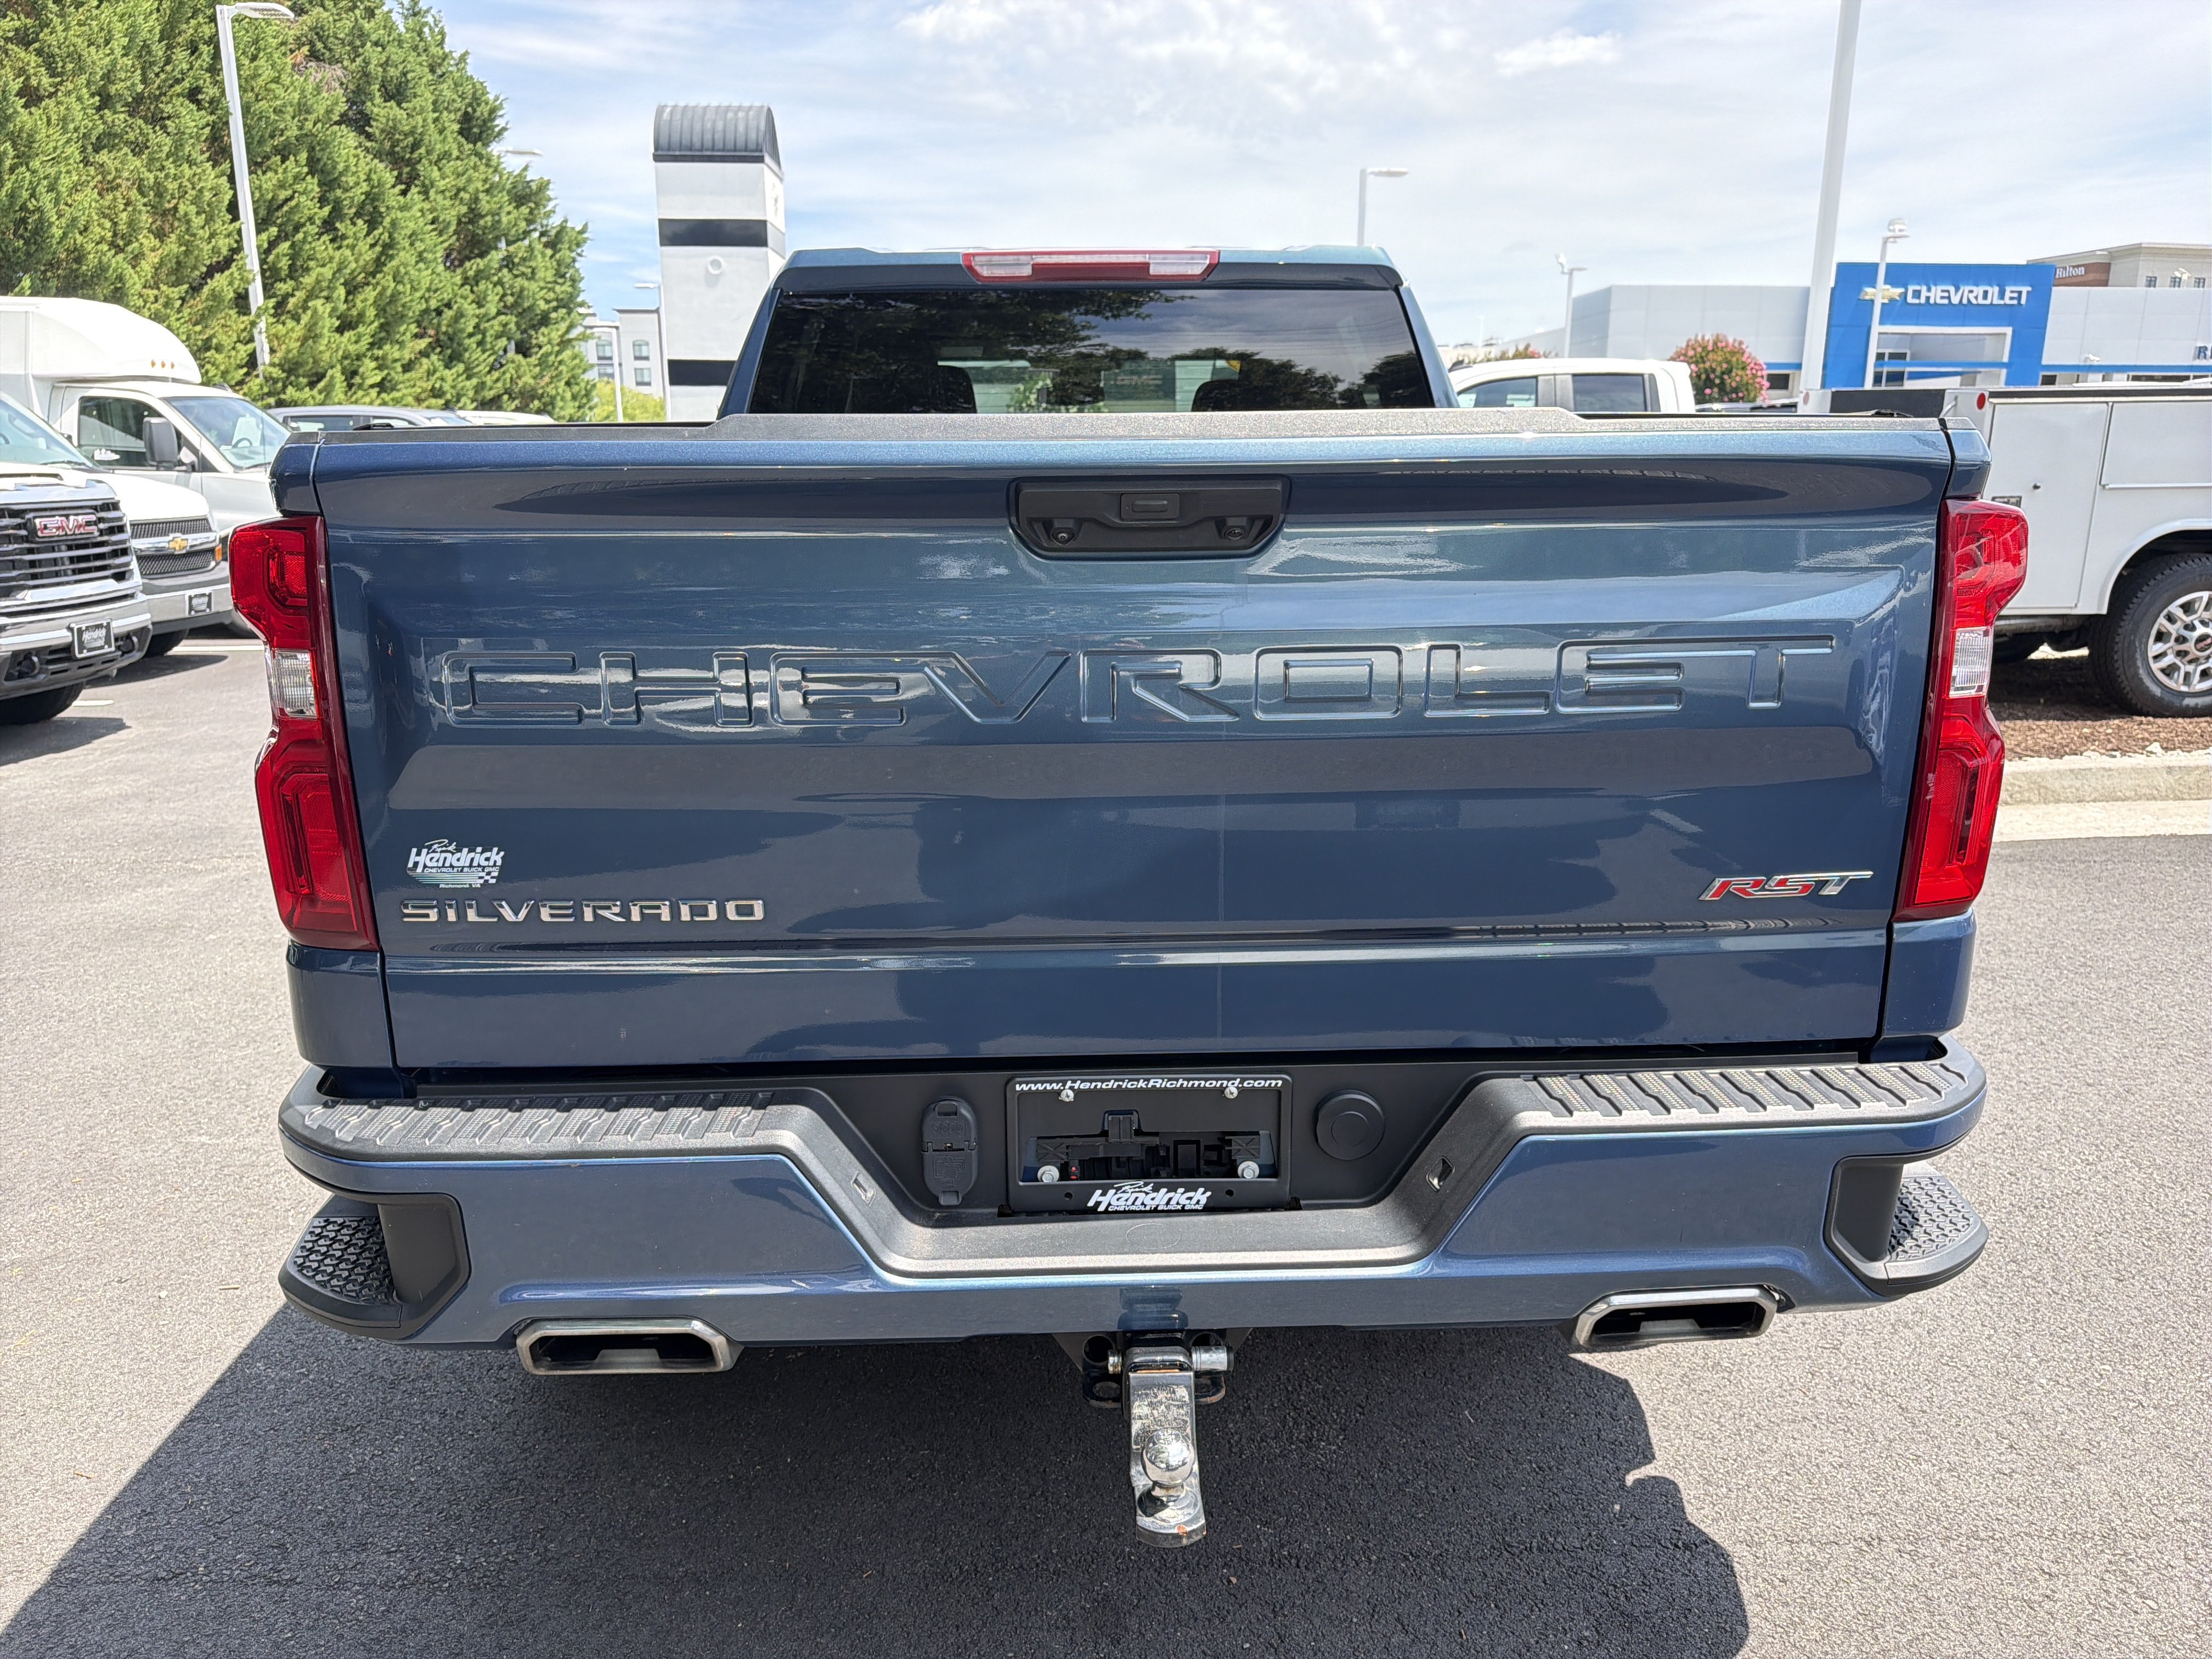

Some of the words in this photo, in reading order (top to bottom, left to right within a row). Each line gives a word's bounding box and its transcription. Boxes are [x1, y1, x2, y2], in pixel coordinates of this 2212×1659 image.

[2055, 266, 2085, 279] Hilton
[1906, 285, 2032, 305] CHEVROLET
[34, 515, 97, 537] GMC
[441, 634, 1836, 727] CHEVROLET
[407, 847, 505, 873] Hendrick
[1698, 869, 1874, 900] RST
[401, 900, 765, 922] SILVERADO
[1015, 1079, 1283, 1091] www.HendrickRichmond.com
[1087, 1188, 1212, 1212] Hendrick
